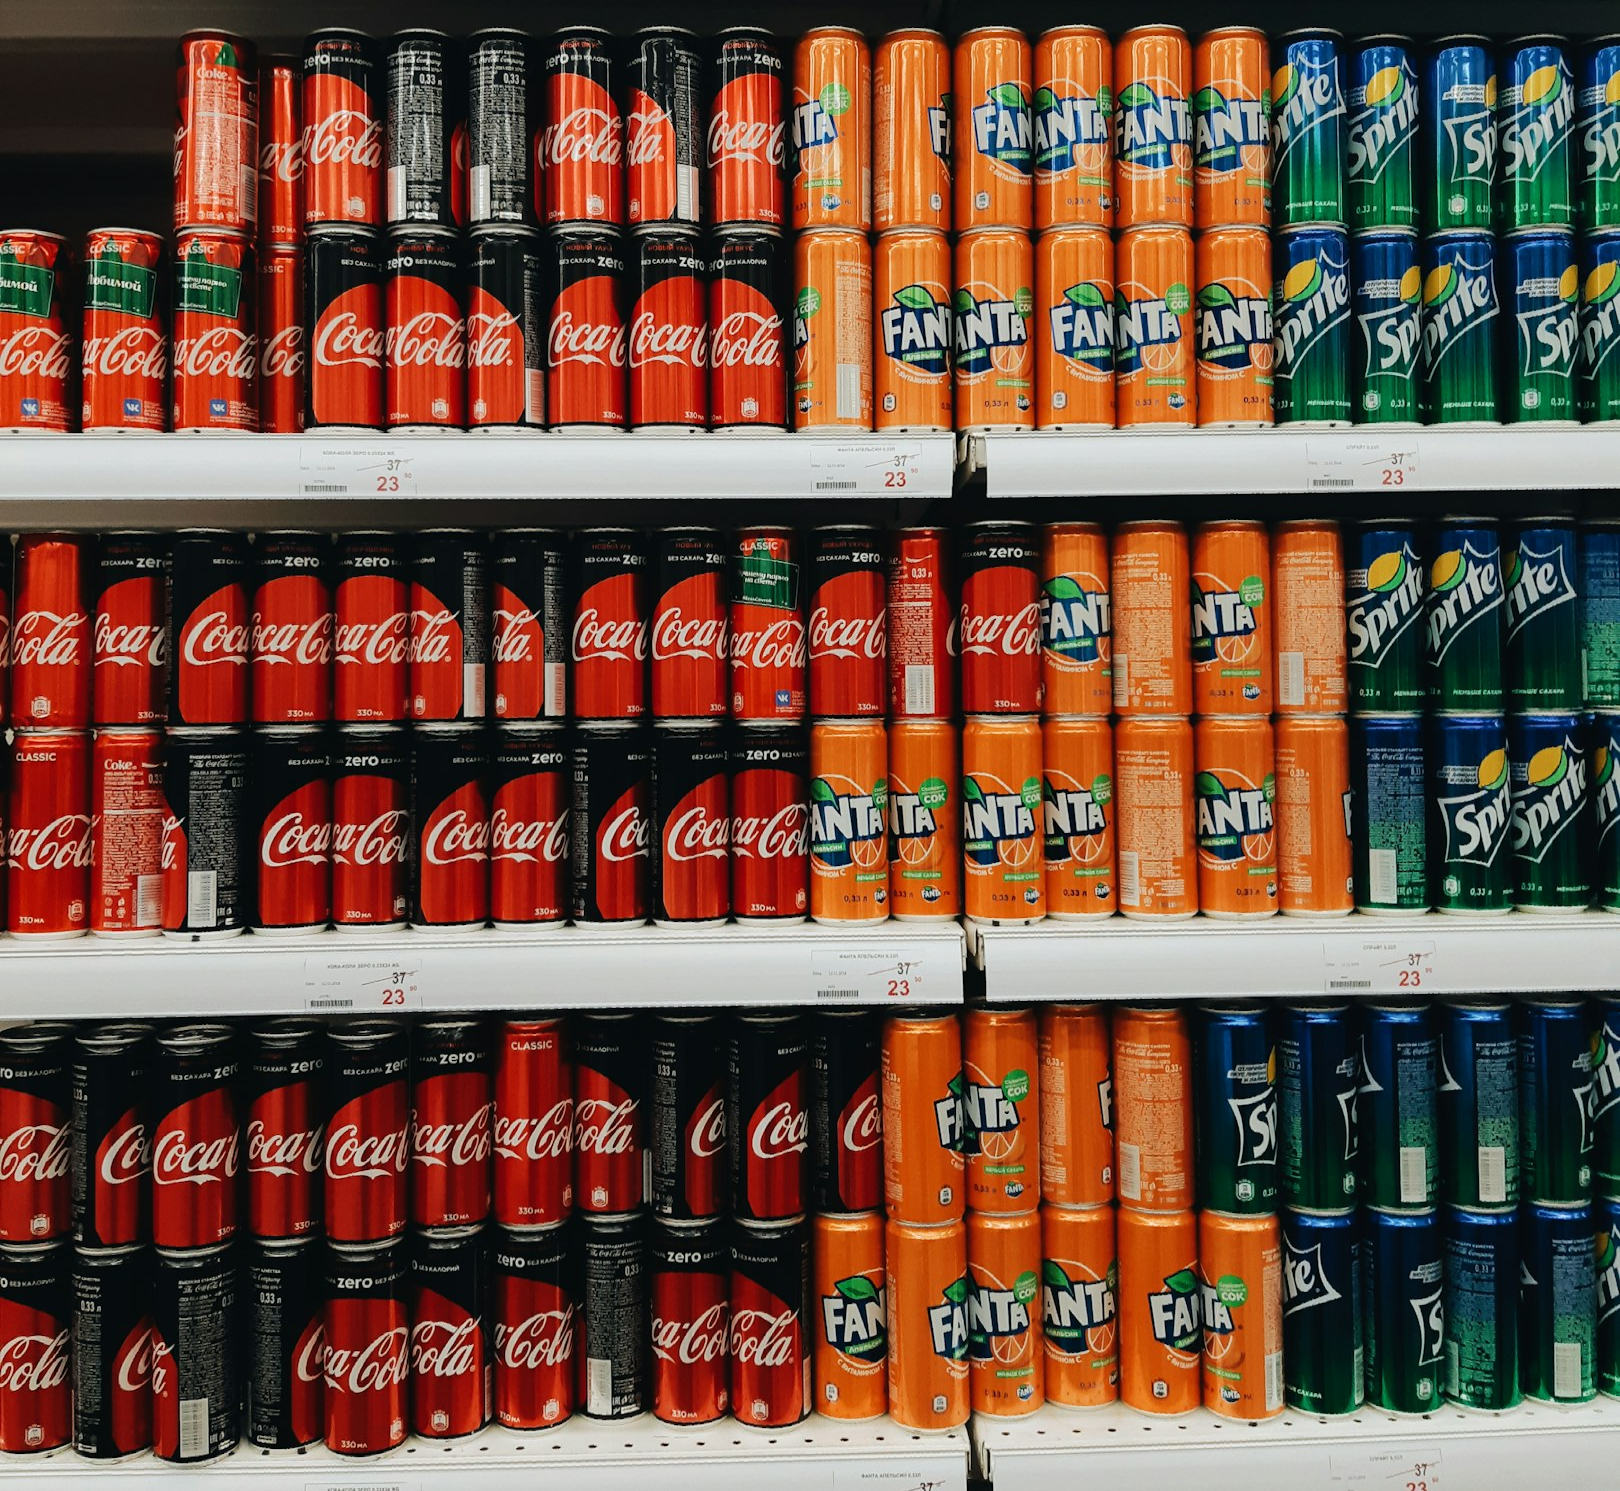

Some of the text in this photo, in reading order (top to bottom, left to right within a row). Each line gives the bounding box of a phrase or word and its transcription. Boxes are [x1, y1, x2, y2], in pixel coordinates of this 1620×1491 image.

[304, 52, 329, 69] zero
[545, 53, 568, 68] zero
[754, 53, 782, 69] zero
[90, 245, 130, 254] CLASSIC
[178, 245, 214, 255] CLASSIC
[387, 254, 412, 270] zero
[597, 256, 624, 271] zero
[679, 255, 704, 270] zero
[740, 258, 766, 266] КАЛОРИЙ
[984, 400, 999, 408] 0,33
[603, 411, 616, 419] 330
[684, 411, 698, 419] 330
[895, 456, 906, 466] 37
[1391, 454, 1403, 464] 37
[387, 460, 401, 471] 37
[885, 472, 906, 487] 23
[1382, 470, 1403, 485] 23
[377, 476, 399, 491] 23
[739, 541, 778, 552] CLASSIC
[852, 550, 880, 564] zero
[989, 546, 1023, 559] zero
[285, 555, 319, 569] zero
[355, 555, 389, 568] zero
[912, 568, 926, 578] 0,33
[627, 705, 641, 713] 330
[994, 699, 1009, 708] 330
[287, 710, 304, 718] 330
[358, 709, 373, 717] 330
[16, 752, 56, 762] CLASSIC
[532, 751, 563, 764] zero
[747, 748, 780, 761] zero
[345, 755, 379, 767] zero
[924, 793, 945, 803] СОК
[1063, 889, 1078, 897] 0,33
[535, 907, 550, 916] 330
[751, 903, 765, 911] 330
[19, 916, 34, 924] 330
[347, 910, 362, 919] 330
[1408, 954, 1421, 966] 37
[898, 963, 910, 974] 37
[393, 972, 405, 984] 37
[1399, 970, 1421, 987] 23
[888, 980, 910, 996] 23
[383, 989, 405, 1004] 23
[511, 1040, 553, 1051] CLASSIC
[439, 1052, 475, 1065] zero
[262, 1058, 323, 1074] САХАРА zero
[185, 1072, 211, 1080] САХАРА
[1008, 1085, 1027, 1097] СОК
[443, 1213, 458, 1221] 330
[294, 1222, 310, 1230] 330
[497, 1253, 525, 1268] zero
[667, 1250, 702, 1263] zero
[337, 1276, 373, 1289] zero
[260, 1292, 275, 1304] 0,33
[1222, 1291, 1245, 1301] СОК
[81, 1300, 95, 1312] 0,33
[672, 1410, 687, 1418] 330
[341, 1440, 356, 1448] 330
[1415, 1464, 1428, 1477] 37
[920, 1483, 933, 1491] 37
